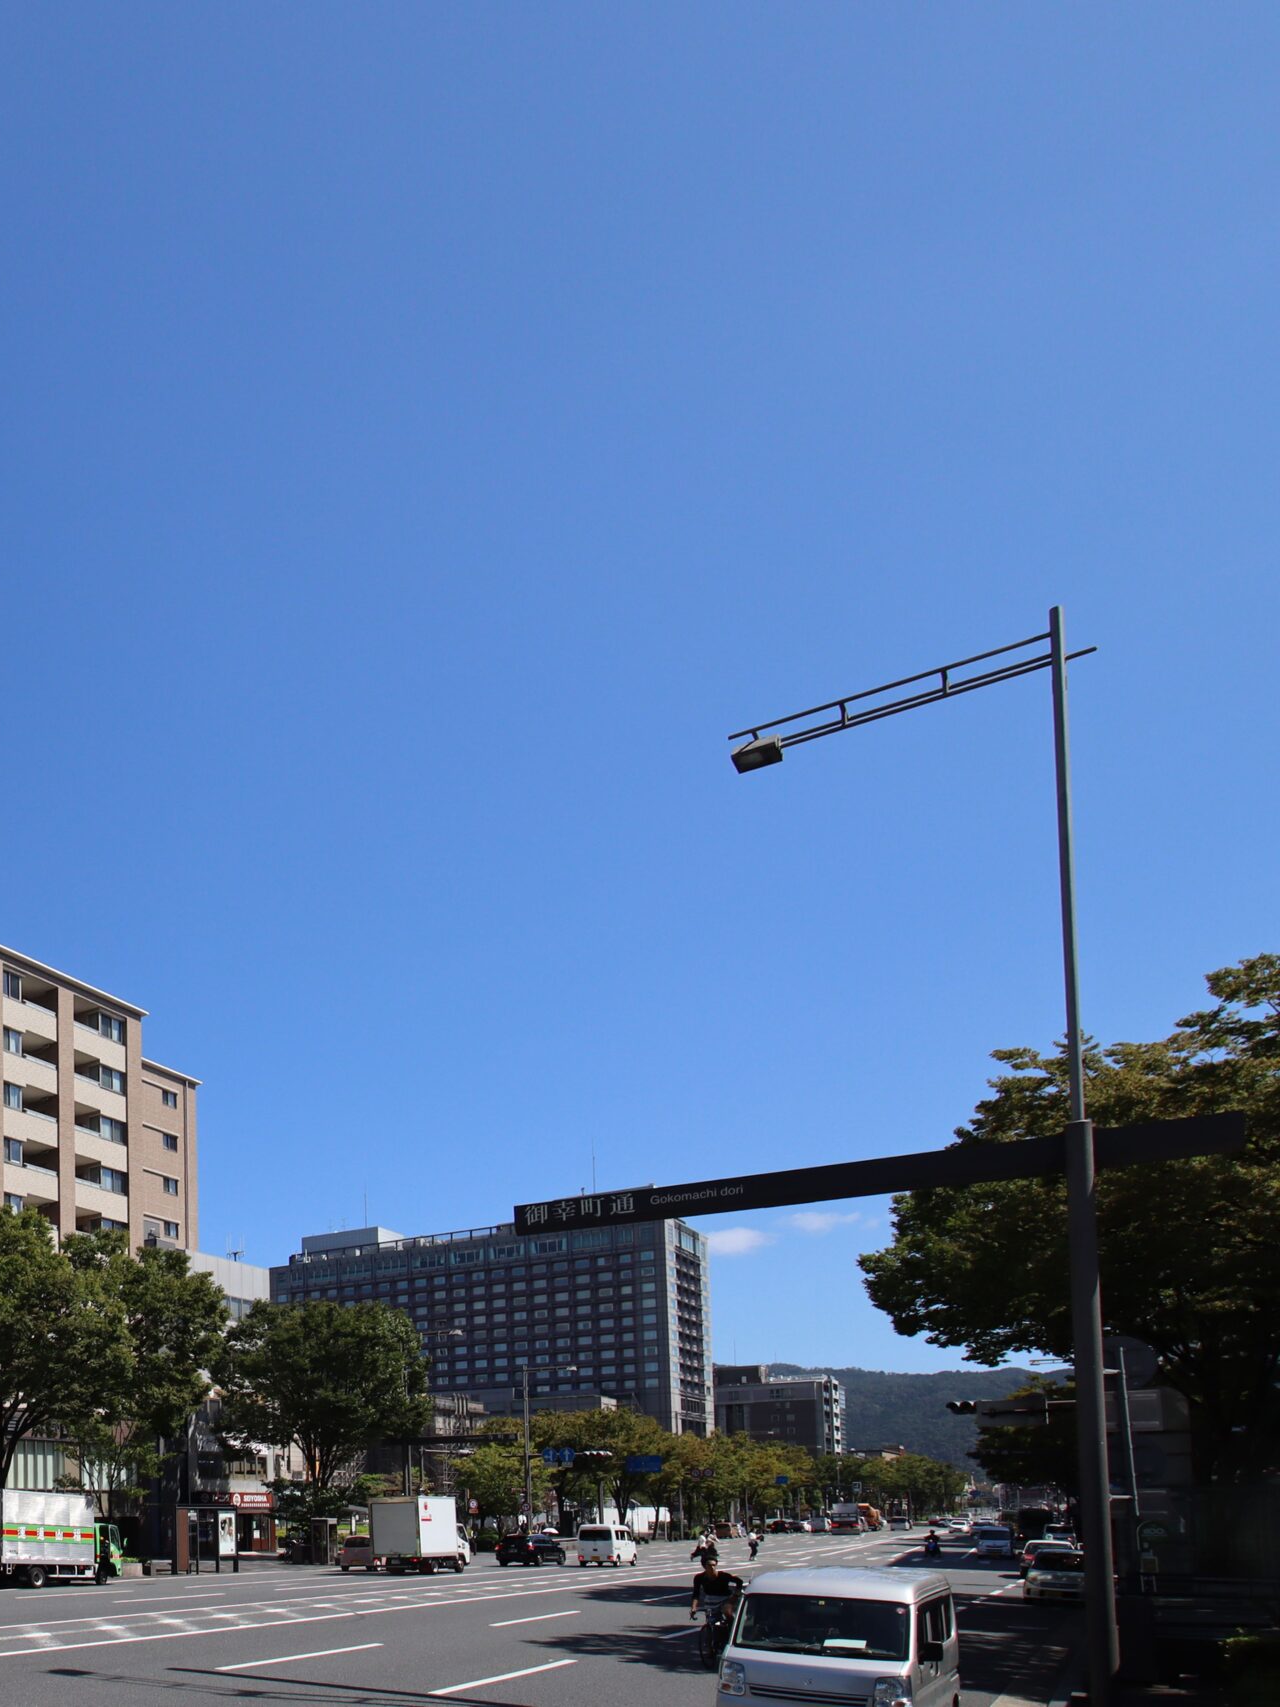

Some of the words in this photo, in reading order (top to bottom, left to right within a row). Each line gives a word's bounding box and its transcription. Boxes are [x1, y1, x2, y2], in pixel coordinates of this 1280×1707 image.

[649, 1188, 717, 1205] Gokomachi
[720, 1184, 744, 1196] dori
[524, 1193, 636, 1225] 御幸町通
